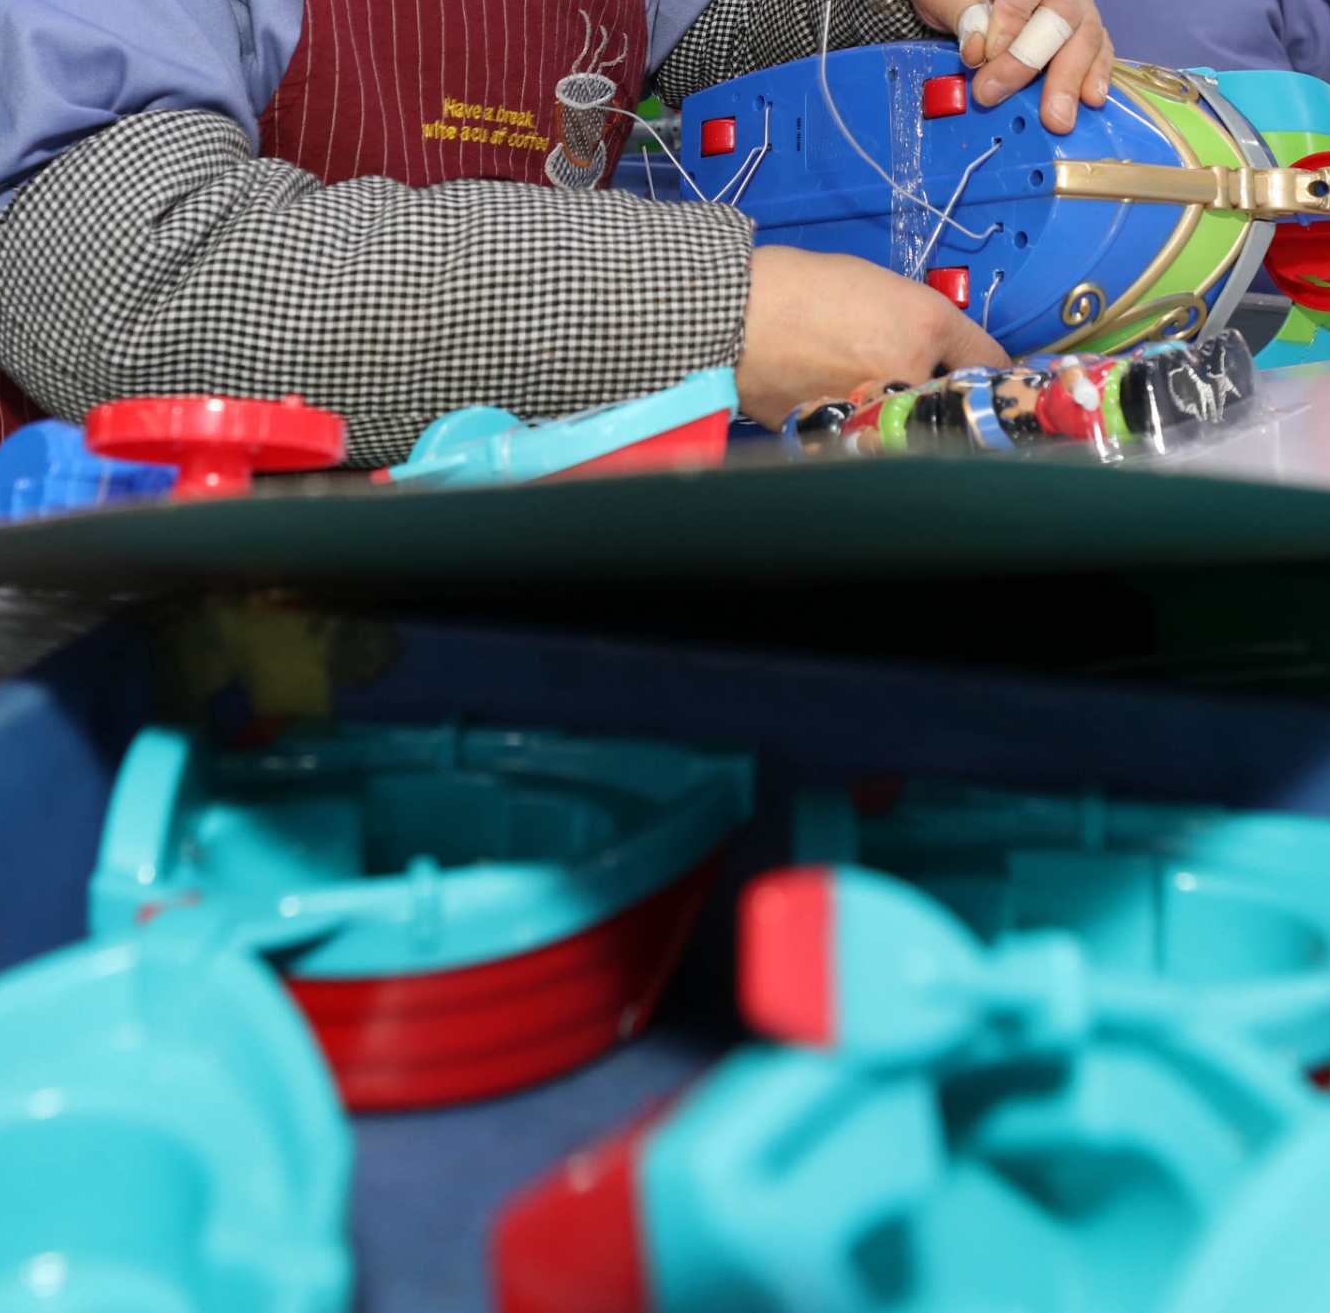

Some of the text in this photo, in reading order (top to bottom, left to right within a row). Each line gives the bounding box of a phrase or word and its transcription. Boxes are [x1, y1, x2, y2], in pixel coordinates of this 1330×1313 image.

[444, 96, 536, 129] Have a break
